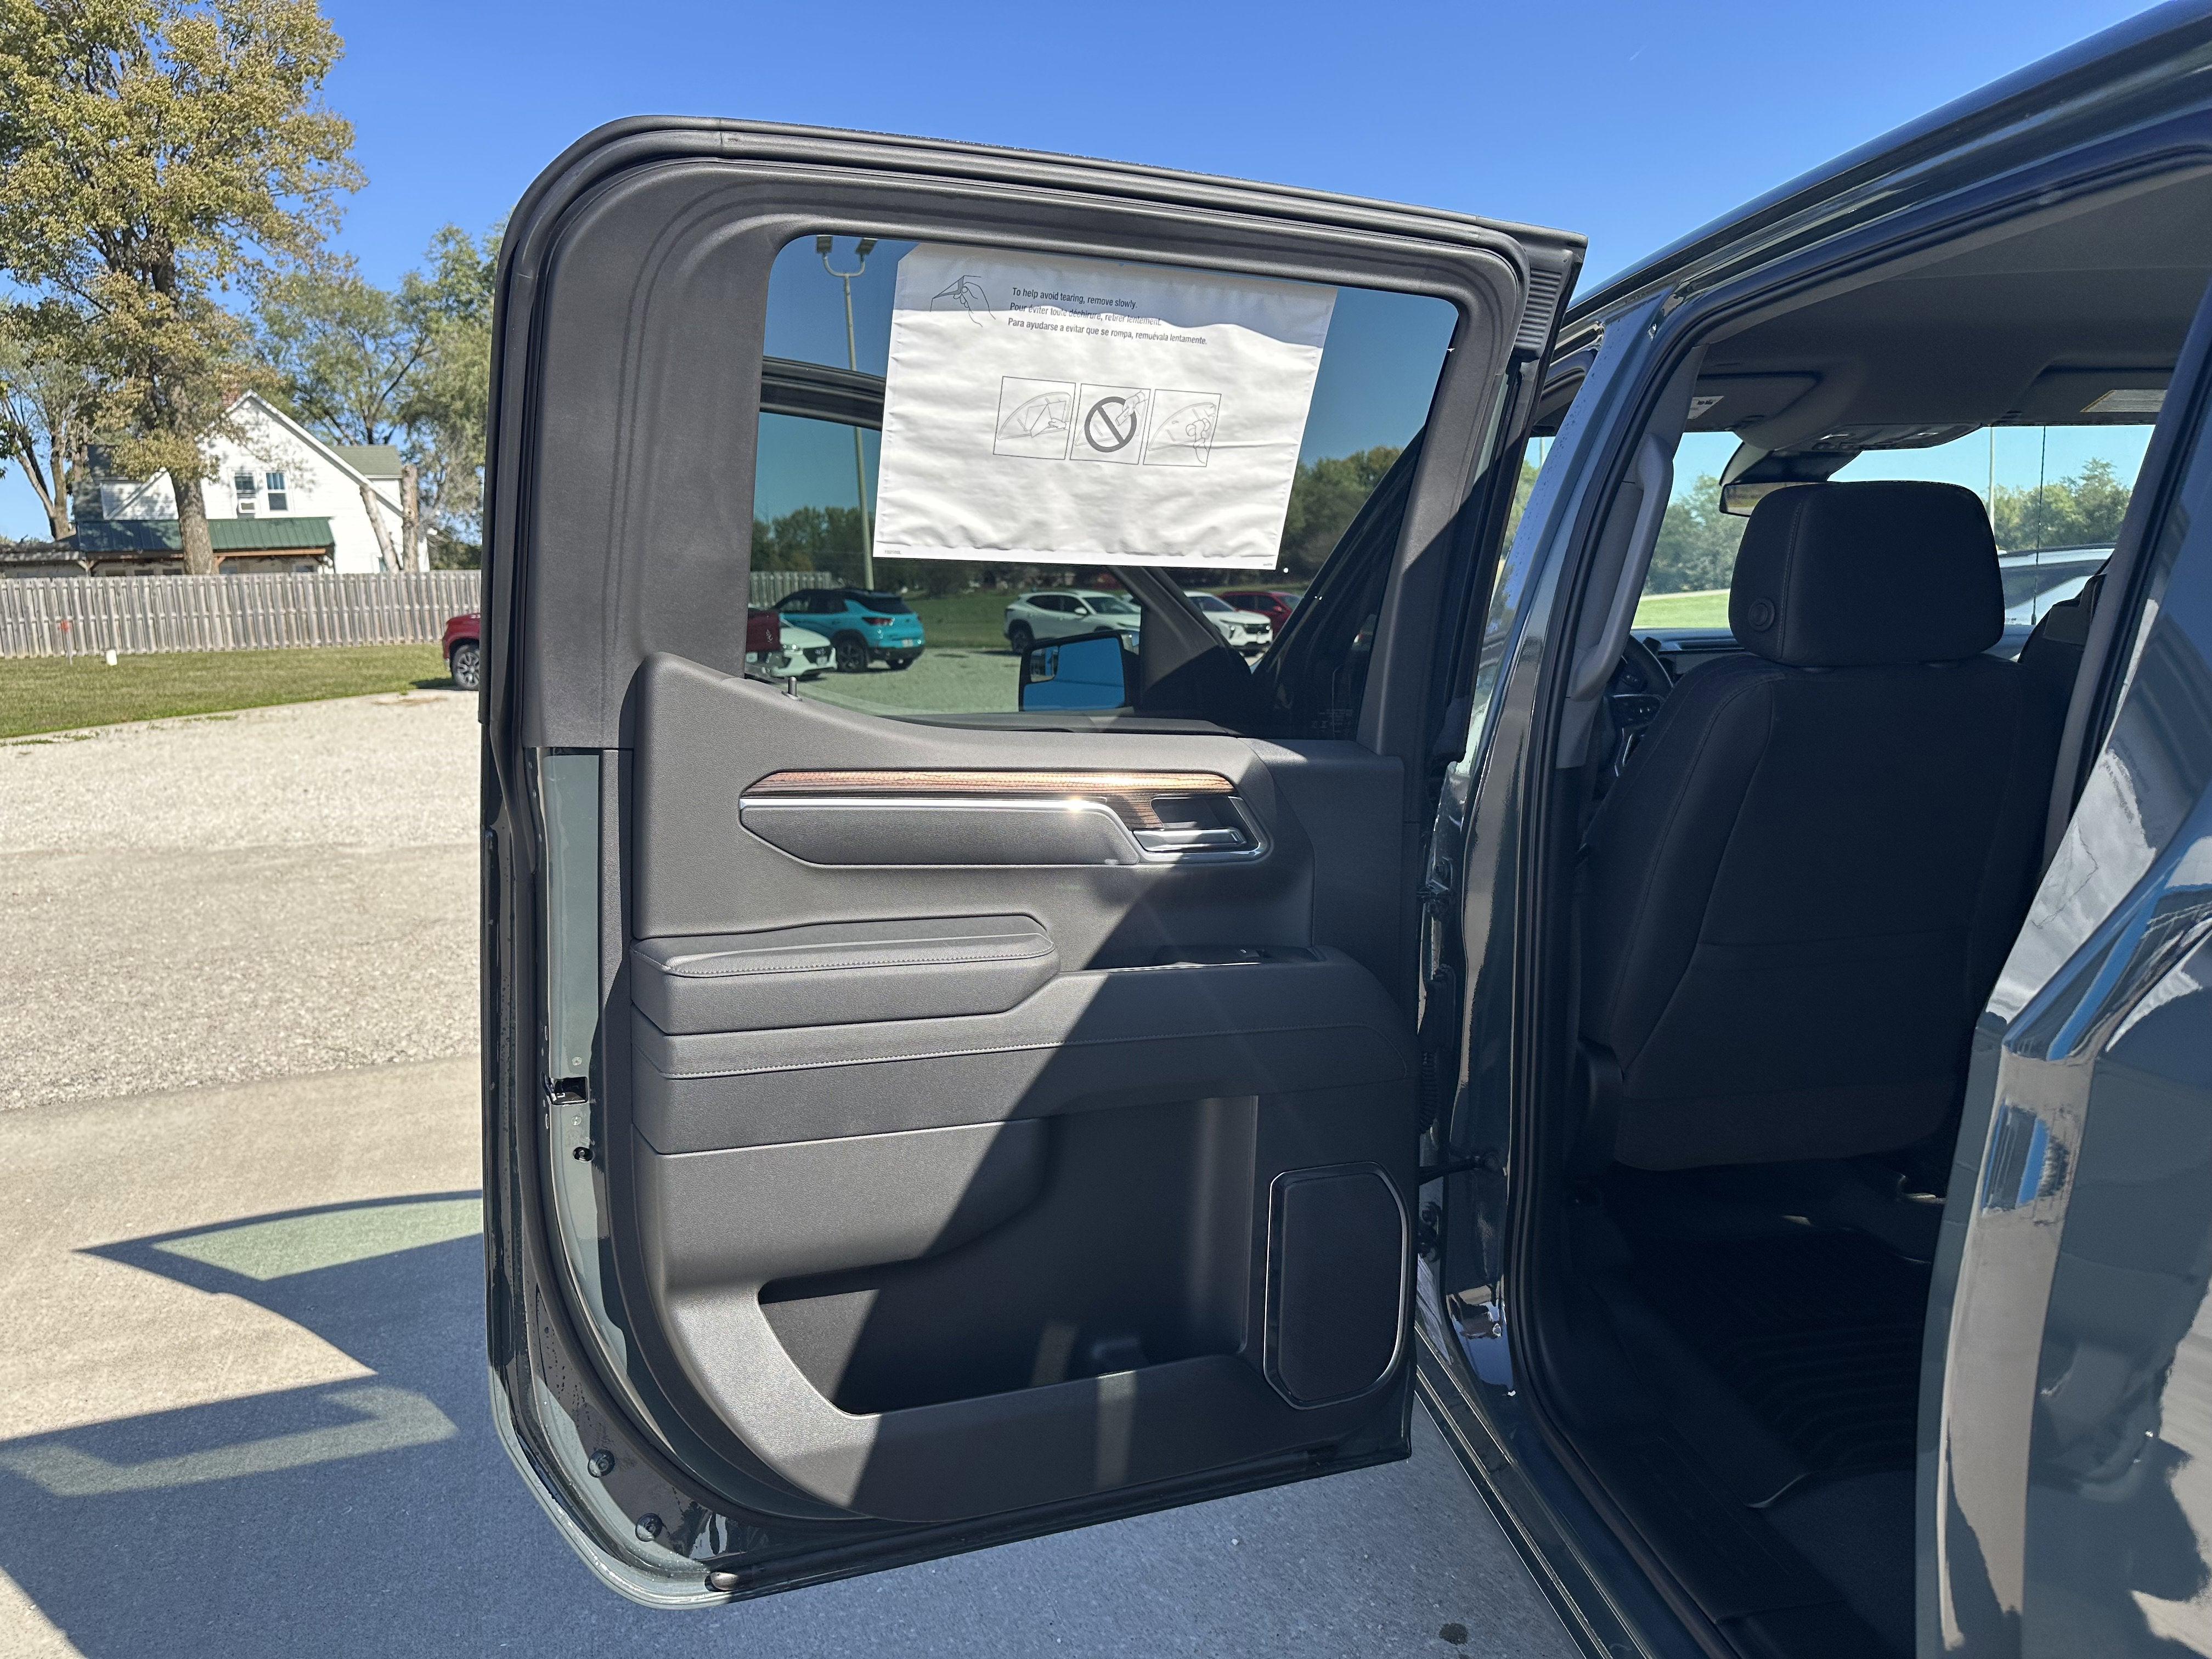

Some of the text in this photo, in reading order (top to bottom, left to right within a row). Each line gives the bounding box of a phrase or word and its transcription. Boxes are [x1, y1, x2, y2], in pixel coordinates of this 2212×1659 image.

[1012, 287, 1137, 309] To help avoid tearing, remove slowly.
[1009, 302, 1027, 312] Pour
[1028, 304, 1049, 314] éviter
[1069, 309, 1103, 321] déchirure,
[1105, 313, 1125, 323] retirer
[1127, 315, 1161, 326] lentement.
[1008, 317, 1025, 327] Para
[1026, 321, 1058, 331] ayudarse
[1065, 324, 1085, 333] evitar
[1086, 327, 1099, 336] que
[1110, 330, 1133, 340] rompa,
[1135, 332, 1169, 341] remuévala
[1170, 334, 1207, 345] lentamente.
